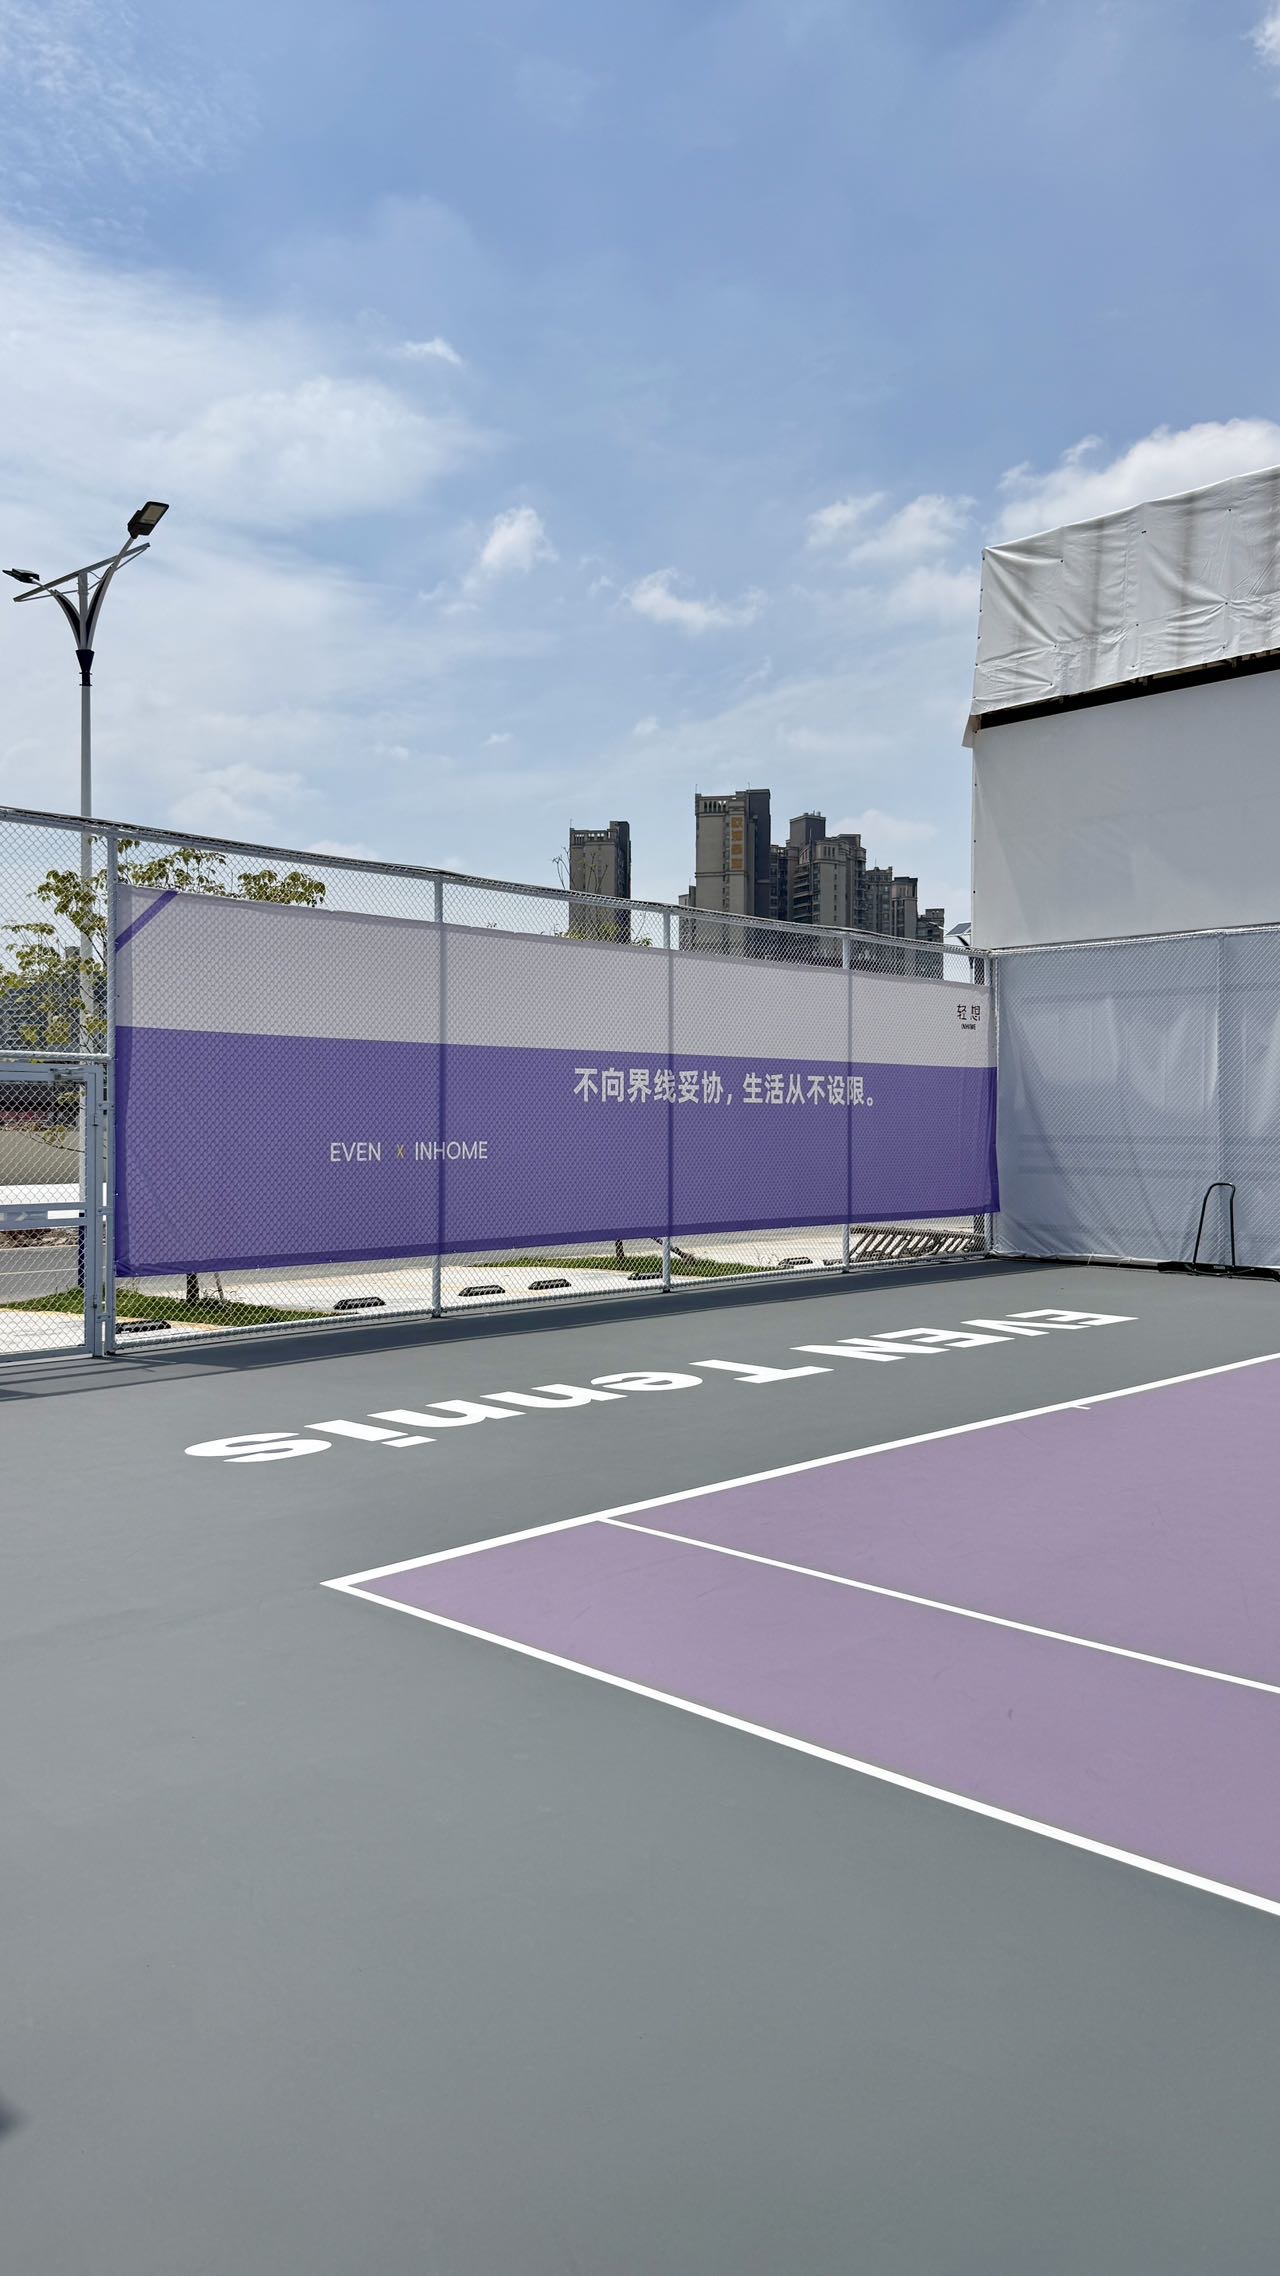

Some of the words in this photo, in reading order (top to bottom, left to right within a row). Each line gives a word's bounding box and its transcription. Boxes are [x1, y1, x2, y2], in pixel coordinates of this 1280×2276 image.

[573, 1066, 874, 1106] 不向界线妥协，生活从不设限。
[330, 1142, 381, 1162] EVEN
[415, 1141, 488, 1160] INHOME
[790, 1309, 1138, 1362] EVEN
[184, 1359, 834, 1463] Tennis
